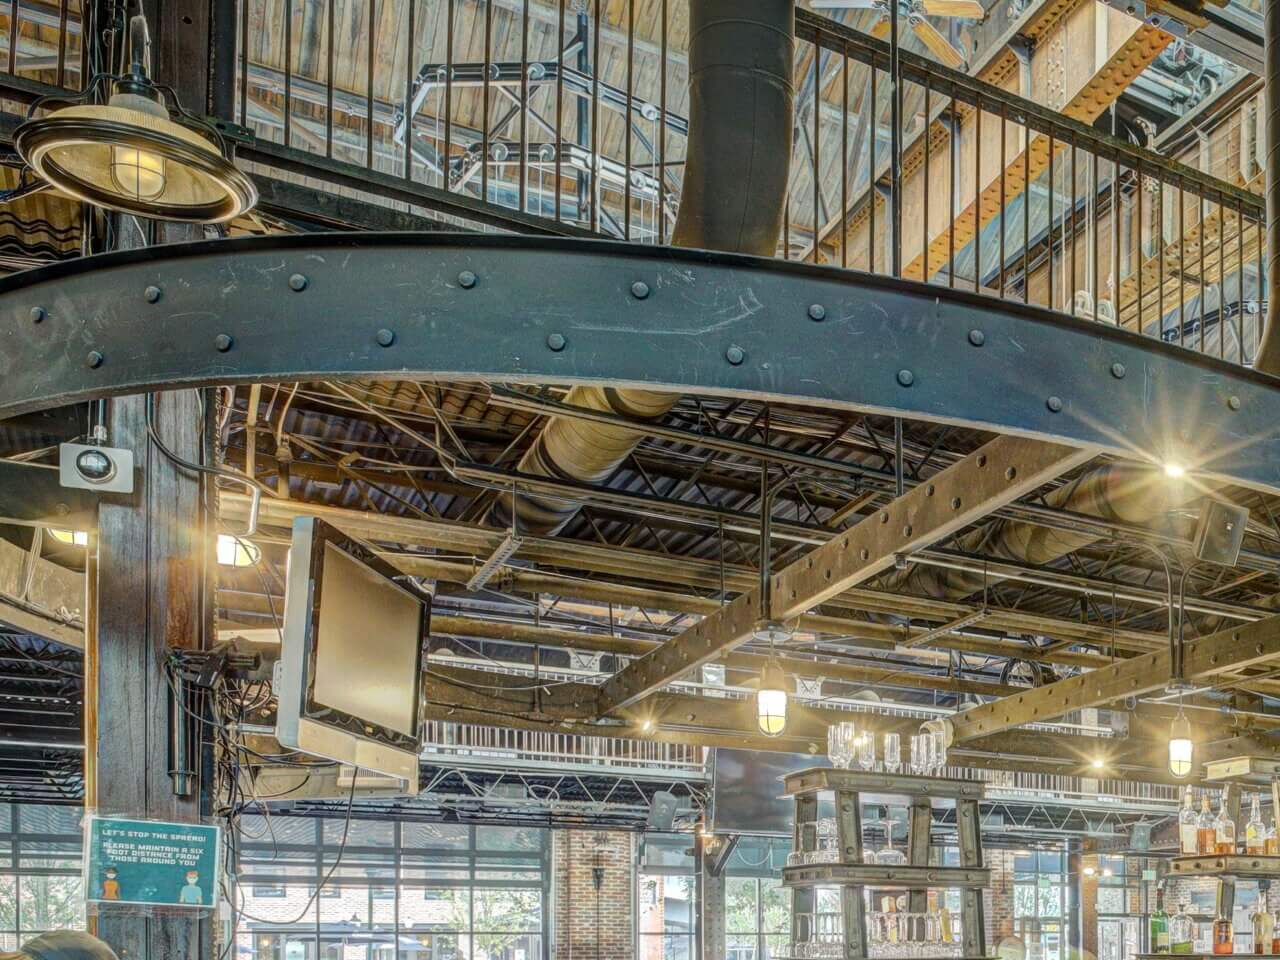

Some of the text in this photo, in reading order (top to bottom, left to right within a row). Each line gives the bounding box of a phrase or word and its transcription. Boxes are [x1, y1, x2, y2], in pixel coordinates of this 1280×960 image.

[102, 829, 125, 837] LET'S
[103, 842, 136, 850] PLEASE
[138, 843, 180, 852] MAINTAIN
[132, 850, 173, 858] DISTANCE
[110, 855, 138, 863] THOSE
[140, 857, 176, 865] AROUND
